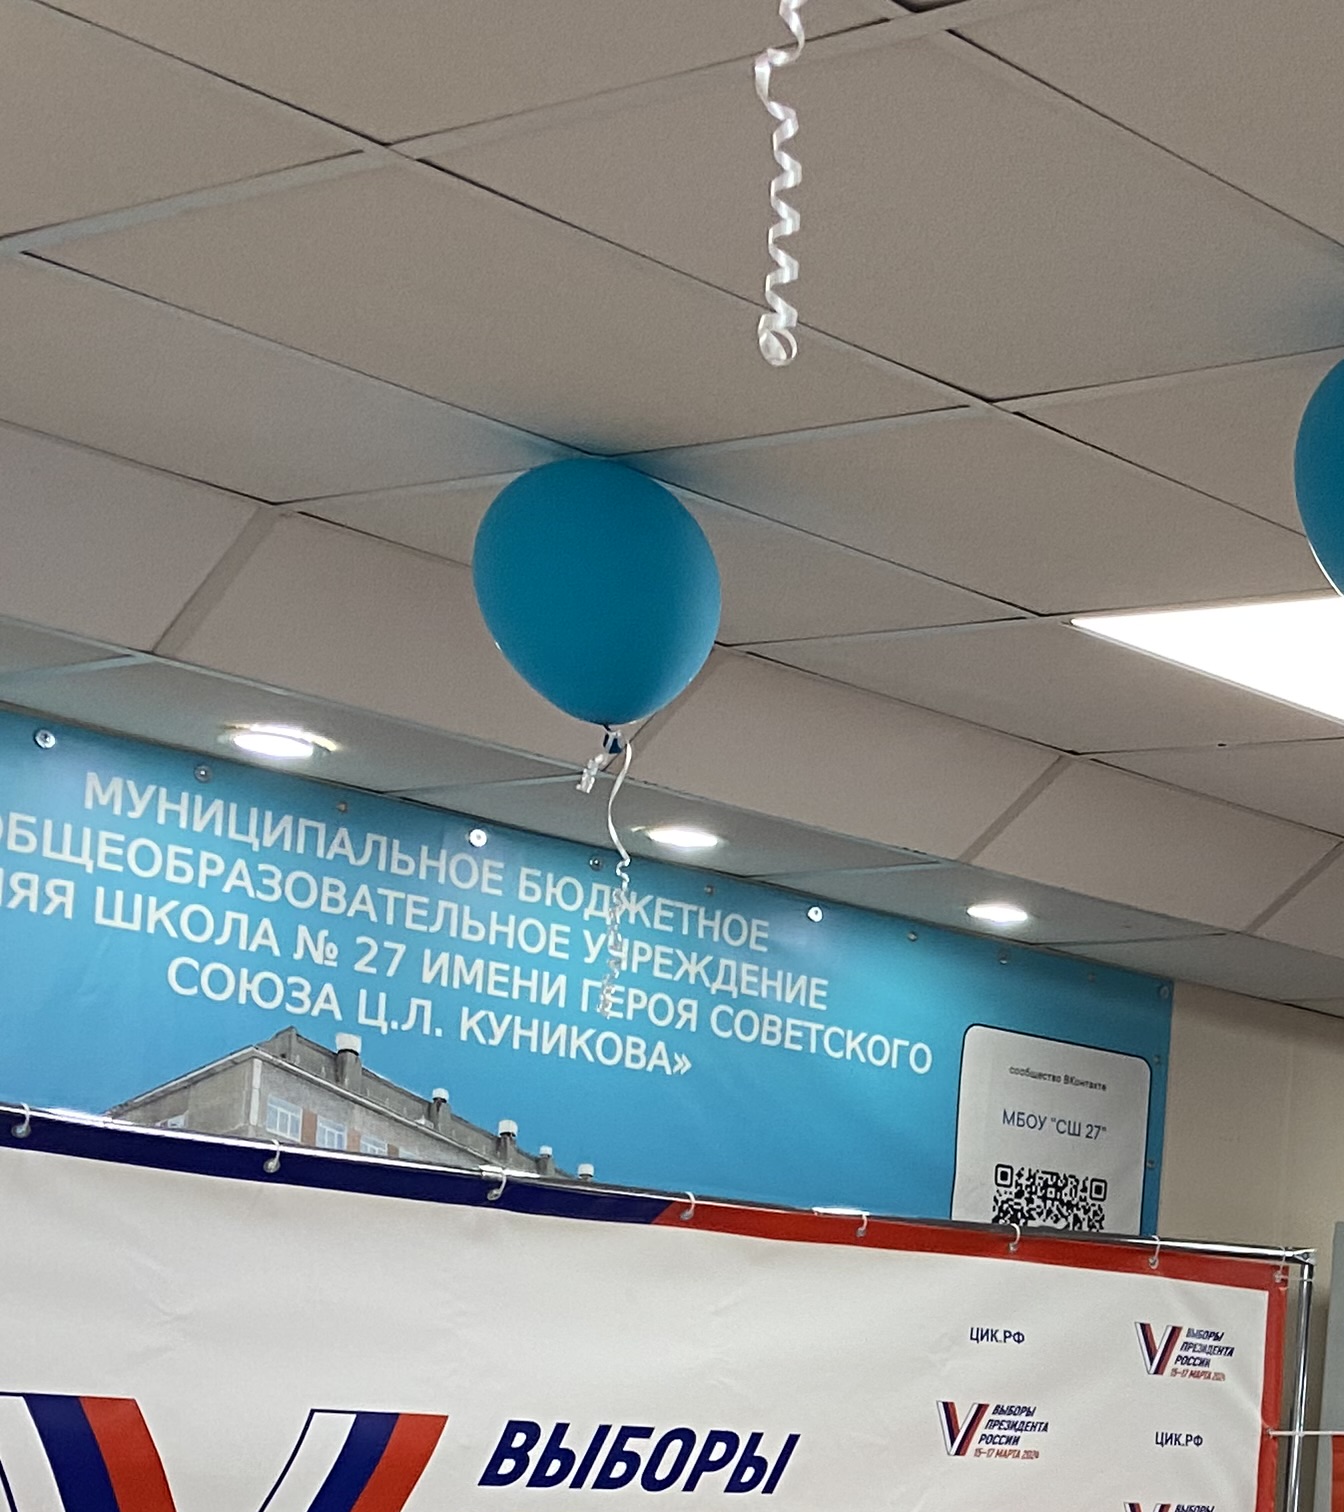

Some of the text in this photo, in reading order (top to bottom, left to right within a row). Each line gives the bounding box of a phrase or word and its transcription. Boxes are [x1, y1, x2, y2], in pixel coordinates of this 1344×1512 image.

[85, 771, 770, 953] МУНИЦИПАЛЬНОЕ БЮДЖЕТНОЕ
[0, 812, 829, 1010] БЩЕОБРАЗОВАТЕЛЬНОЕ УЧРЕЖДЕНИЕ
[0, 869, 934, 1076] ЯЯ ШКОЛА № 27 ИМЕНИ ГЕРОЯ СОВЕТСКОГО
[166, 955, 693, 1078] СОЮЗА Ц.Л. КУНИКОВА»
[1009, 1065, 1061, 1084] сообщество
[1002, 1109, 1107, 1140] МБОУ "СШ 27"
[970, 1327, 1025, 1344] ЦИК.РФ
[1186, 1327, 1224, 1341] ВЫБОРЫ
[1180, 1341, 1235, 1357] ПРЕЗИДЕНТА
[1174, 1355, 1210, 1368] РОССИИ
[992, 1404, 1036, 1417] ВЫБОРЫ
[985, 1419, 1048, 1433] ПРЕЗИДЕНТА
[978, 1434, 1020, 1446] РОССИИ
[1155, 1432, 1203, 1447] ЦИК.РФ
[478, 1419, 801, 1494] ВЫБОРЫ
